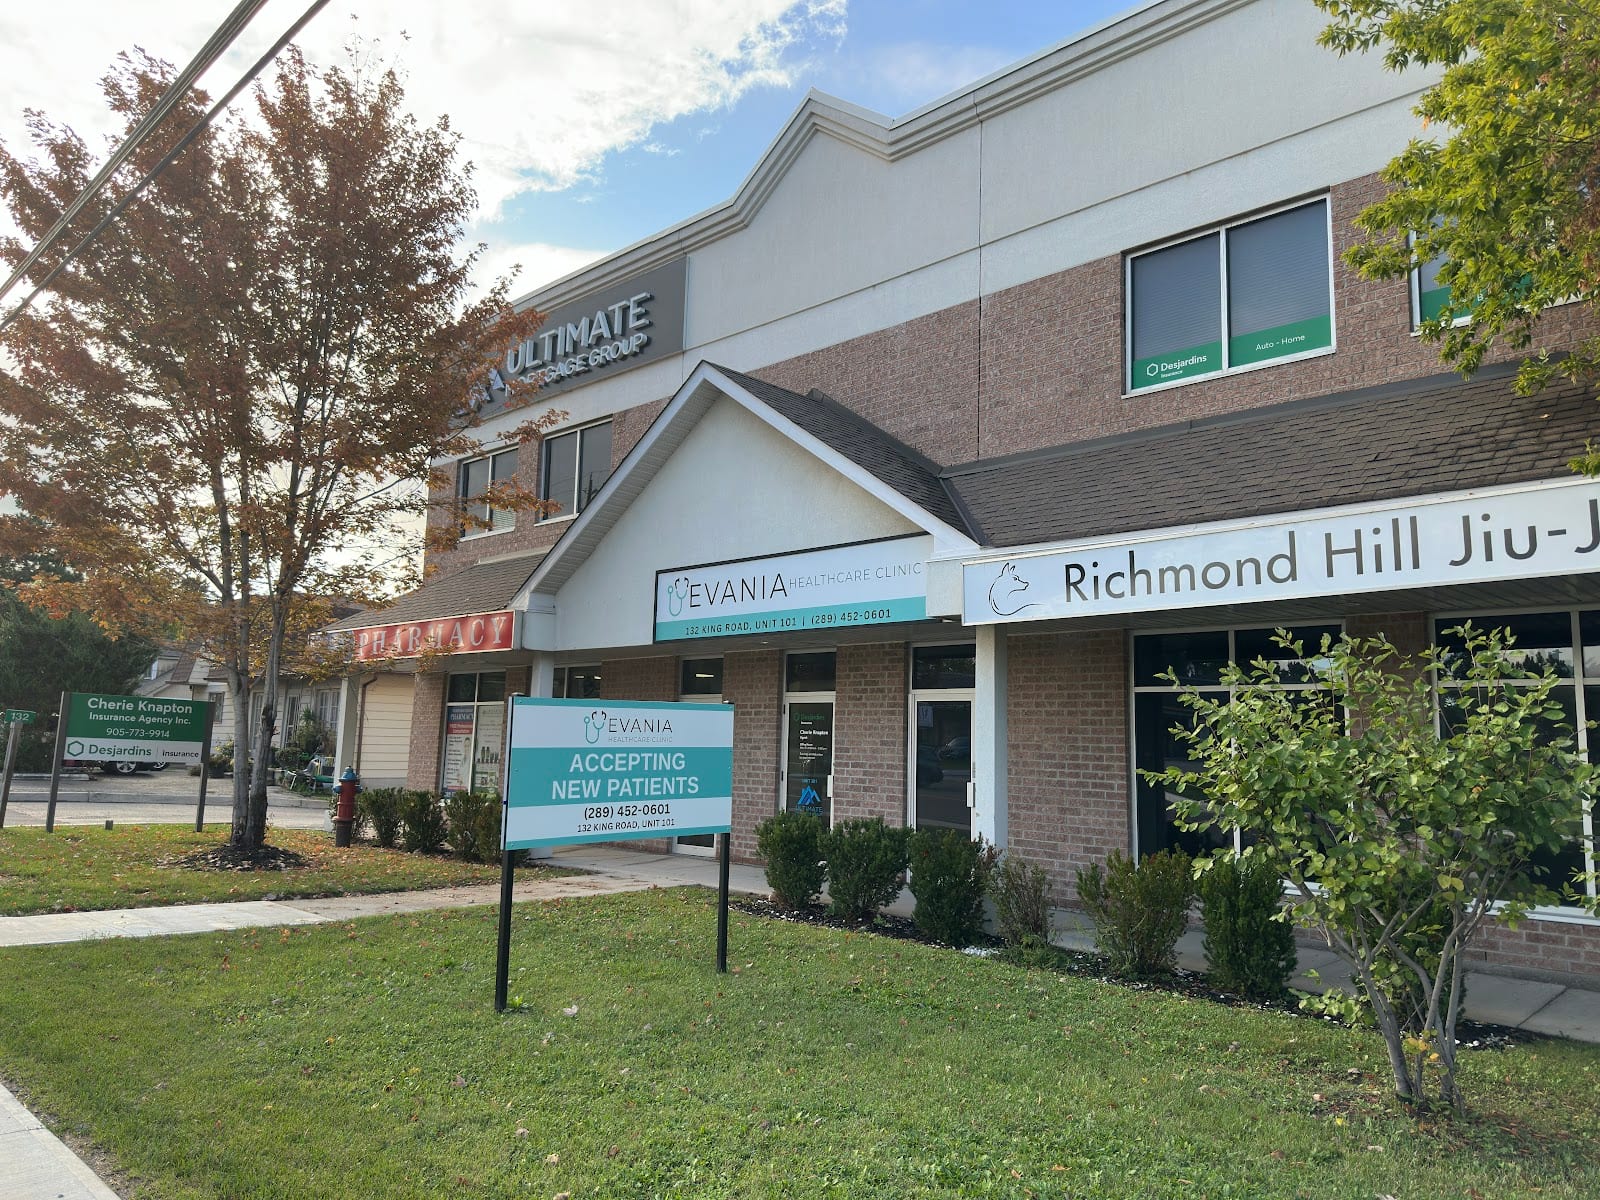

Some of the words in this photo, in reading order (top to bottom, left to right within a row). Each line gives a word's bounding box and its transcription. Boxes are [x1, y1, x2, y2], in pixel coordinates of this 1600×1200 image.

[507, 292, 651, 374] ULTIMATE
[589, 333, 648, 366] GROUP
[1255, 342, 1275, 351] Auto
[1281, 335, 1306, 345] Home
[1160, 355, 1207, 371] Desjardins
[1064, 531, 1298, 602] Richmond
[1325, 515, 1420, 577] Hill
[1448, 498, 1600, 567] Jiu-J
[789, 568, 871, 589] HEALTHCARE
[875, 562, 921, 579] CLINIC
[689, 573, 788, 608] EVANIA
[685, 626, 699, 635] 132
[701, 624, 722, 634] KING
[725, 621, 752, 632] ROAD,
[755, 619, 776, 629] UNIT
[780, 617, 797, 627] 101
[811, 614, 837, 625] (289)
[840, 608, 891, 622] 452-0601
[358, 616, 507, 657] PHARMACY
[87, 698, 134, 711] Cherie
[138, 701, 193, 714] Knapton
[11, 712, 30, 720] 132
[89, 712, 136, 722] Insurance
[138, 715, 173, 725] Agency
[175, 716, 191, 725] Inc.
[106, 728, 170, 738] 905-773-9914
[608, 718, 673, 733] EVANIA
[88, 744, 152, 757] Desjardins
[162, 750, 199, 758] Insurance
[569, 752, 686, 773] ACCEPTING
[551, 779, 602, 800] NEW
[607, 776, 699, 798] PATIENTS
[584, 806, 614, 820] (289)
[617, 803, 671, 817] 452-0601
[577, 824, 591, 833] 132
[593, 822, 614, 831] KING
[615, 821, 640, 830] ROAD,
[642, 819, 660, 828] UNIT
[661, 818, 675, 827] 101
